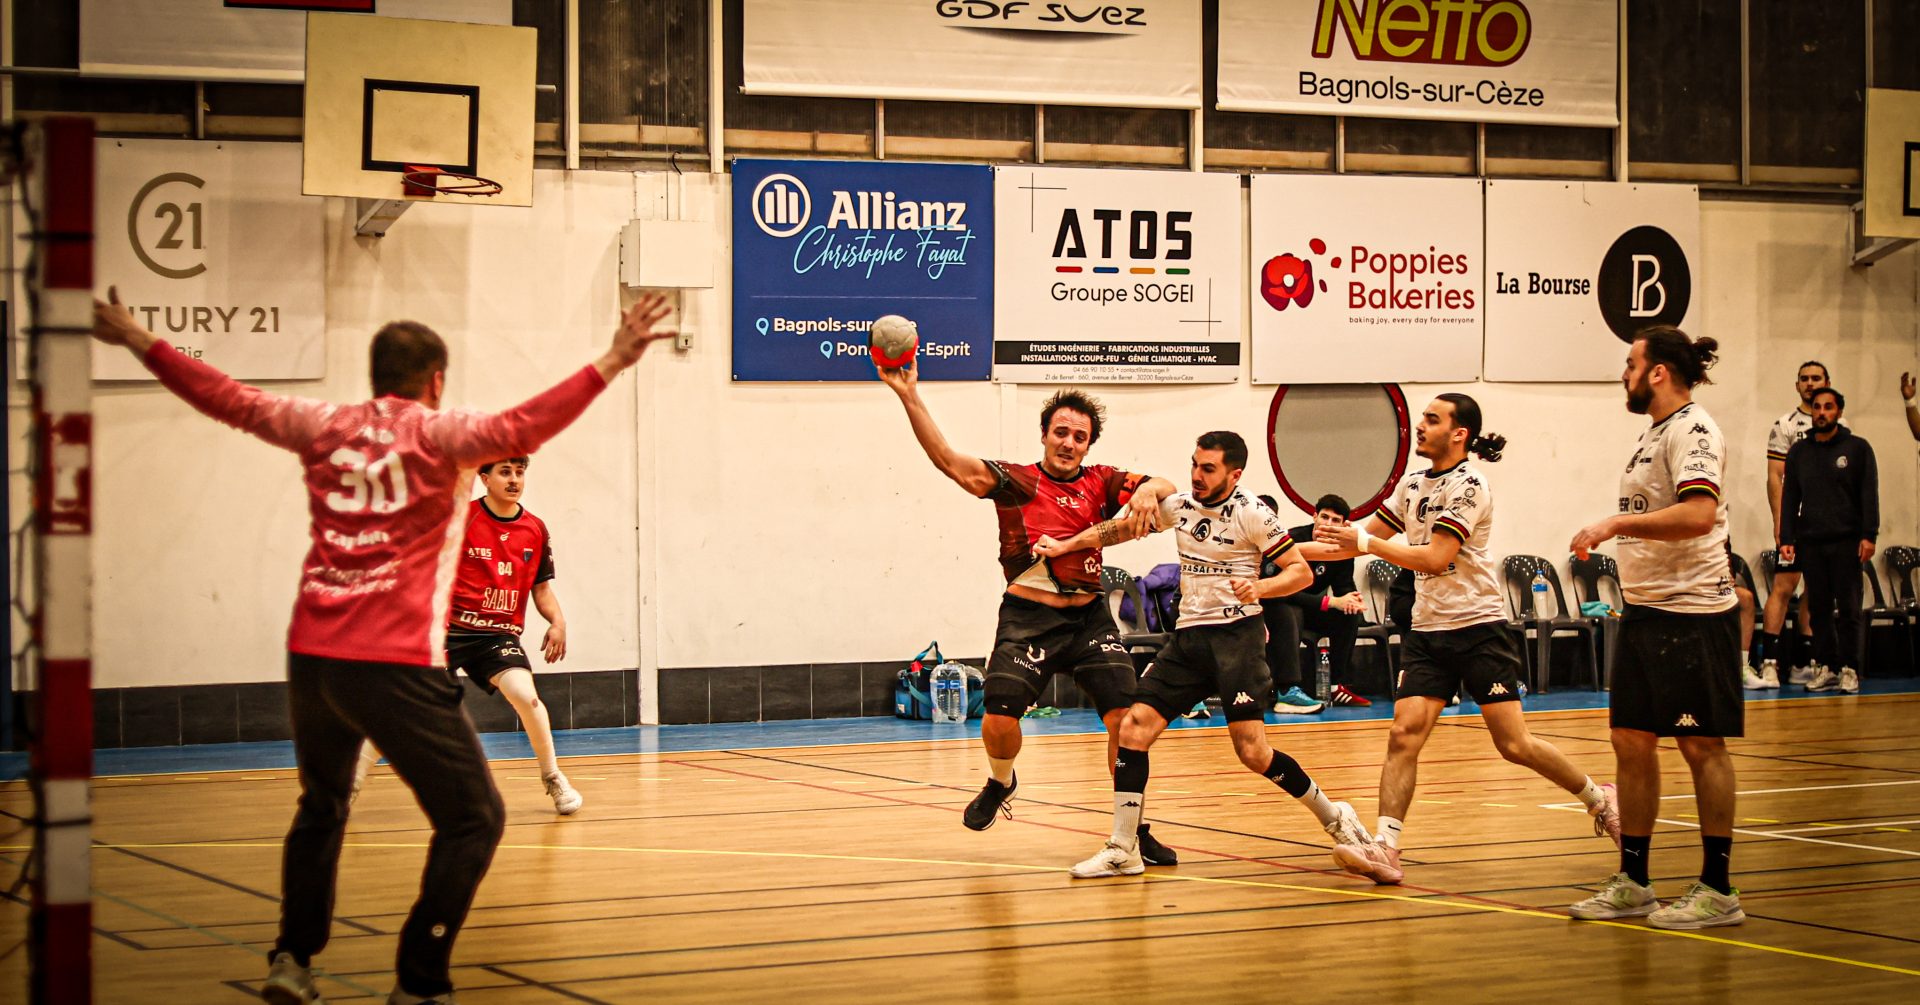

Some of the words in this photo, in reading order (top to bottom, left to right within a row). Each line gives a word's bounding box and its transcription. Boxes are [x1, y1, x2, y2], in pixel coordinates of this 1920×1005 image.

[936, 0, 1029, 20] GDF
[1299, 71, 1545, 106] Bagnols-sur-Cèze
[827, 190, 967, 231] Allianz
[1052, 208, 1193, 260] ATOS
[793, 224, 907, 279] Christophe
[1351, 245, 1468, 282] Poppies
[1051, 282, 1128, 306] Groupe
[1134, 284, 1193, 302] SOGEI
[1349, 281, 1475, 309] Bakeries
[1496, 272, 1520, 294] La
[1528, 272, 1591, 295] Bourse
[250, 306, 280, 333] 21
[1349, 316, 1374, 325] baking
[1392, 317, 1412, 325] every
[1414, 316, 1428, 325] day
[1021, 354, 1078, 362] INSTALLATIONS
[1080, 355, 1119, 363] COUPE-FEU
[1128, 354, 1150, 363] GÉNIE
[1151, 355, 1192, 363] CLIMATIQUE
[1198, 355, 1217, 363] HVAC
[1029, 343, 1057, 352] ÉTUDES
[1058, 343, 1100, 352] INGÉNIERIE
[1108, 345, 1160, 353] FABRICATIONS
[1161, 345, 1210, 353] INDUSTRIELLES
[326, 448, 408, 513] 30
[468, 547, 492, 557] ATOS
[497, 561, 513, 576] 84
